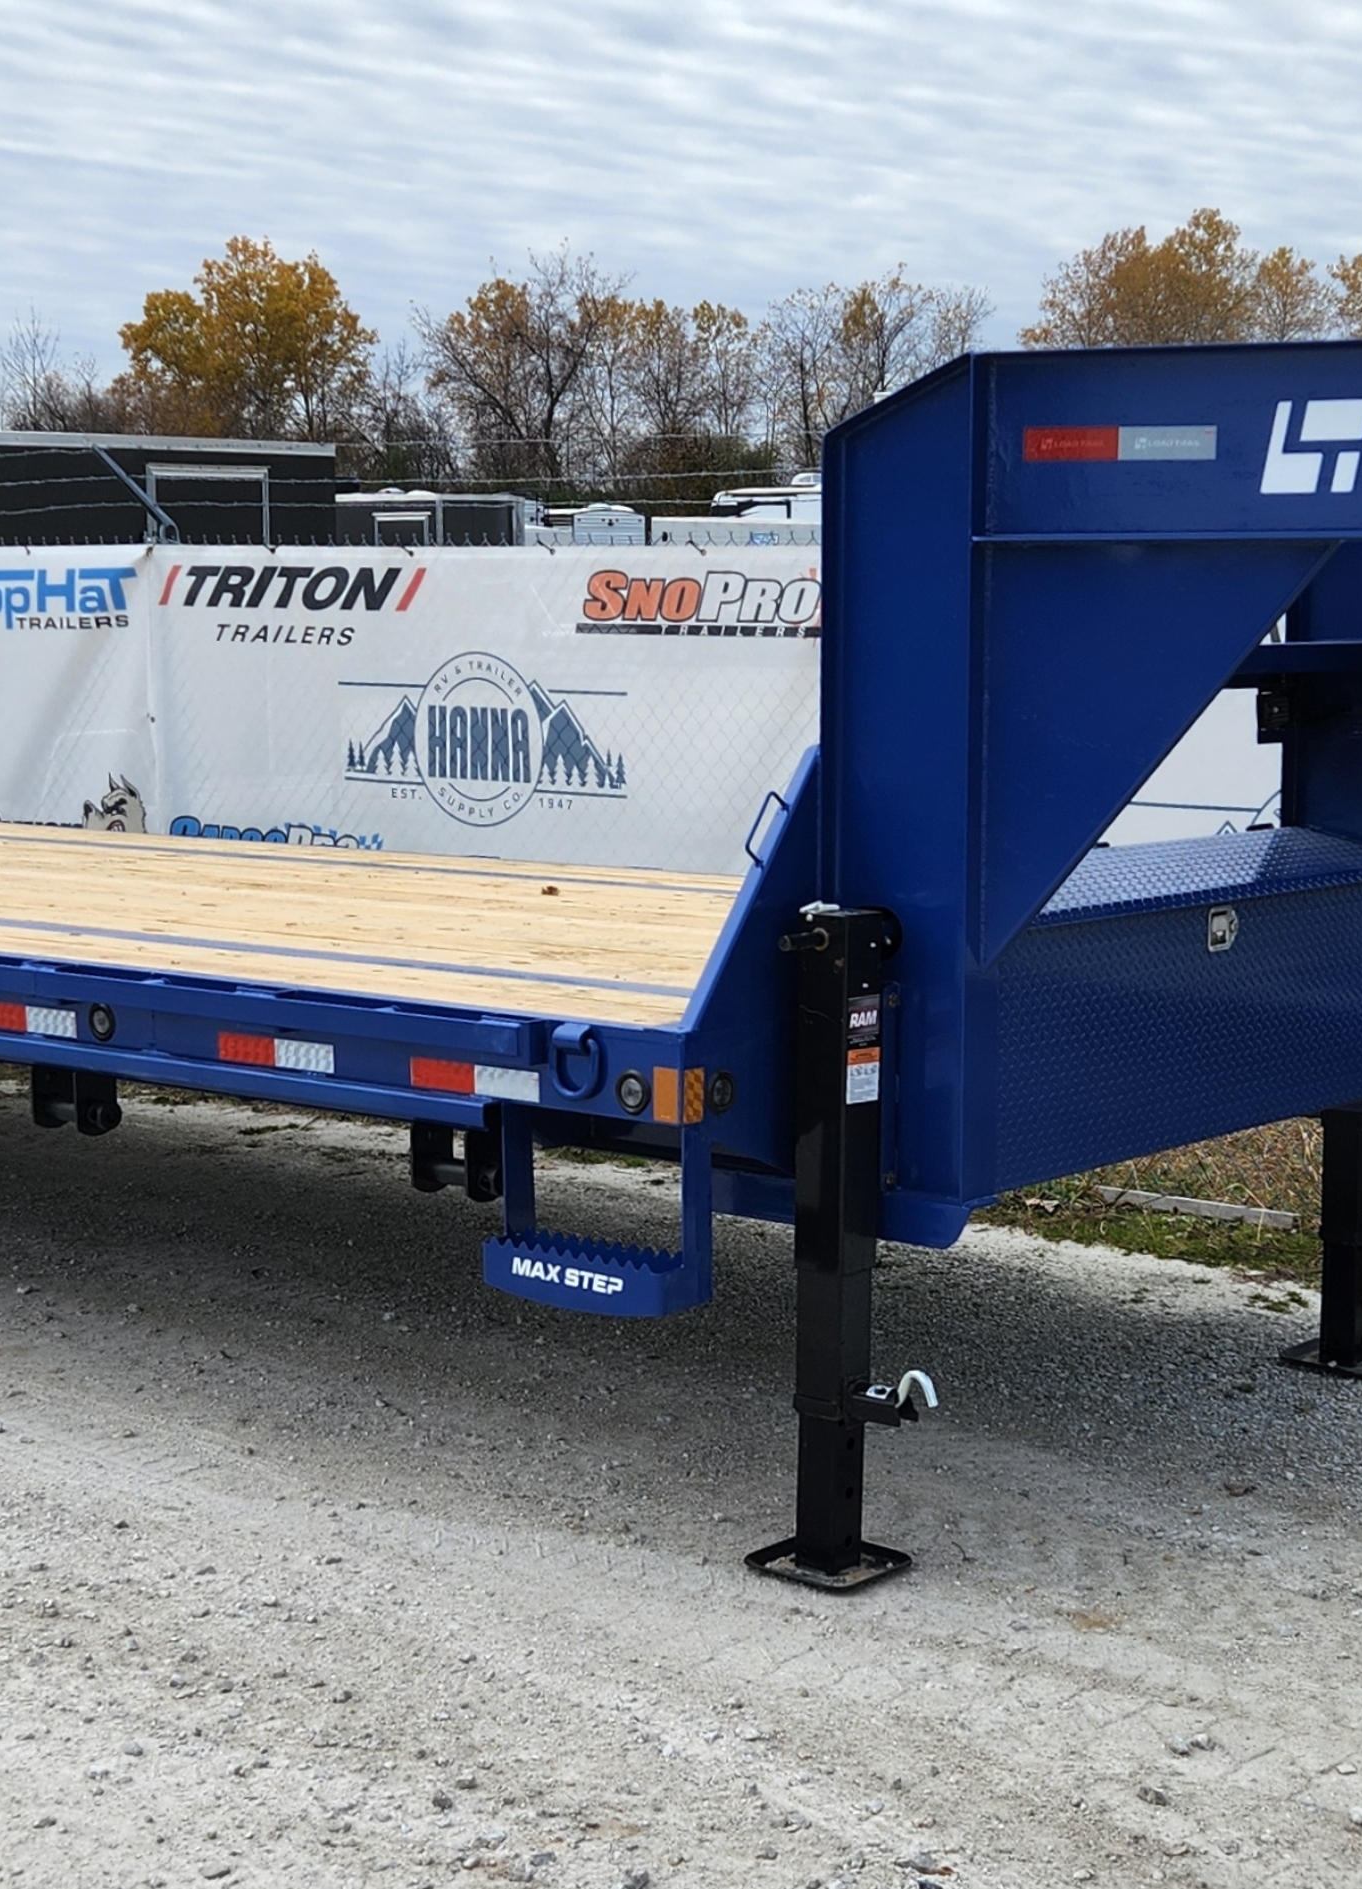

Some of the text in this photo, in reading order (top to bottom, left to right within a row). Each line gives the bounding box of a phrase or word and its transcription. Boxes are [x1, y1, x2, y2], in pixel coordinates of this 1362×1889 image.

[183, 566, 403, 611] TRITON
[16, 615, 129, 630] TRAILERS
[216, 624, 355, 646] TRAILERS
[660, 625, 806, 638] TRAILERS
[434, 660, 522, 697] RV & TRAILER
[428, 705, 531, 783] HANNA
[391, 788, 422, 800] EST.
[437, 787, 495, 818] SUPPLY
[539, 797, 573, 809] 1947
[849, 1010, 877, 1028] RAM
[512, 1256, 624, 1294] MAX STEP
